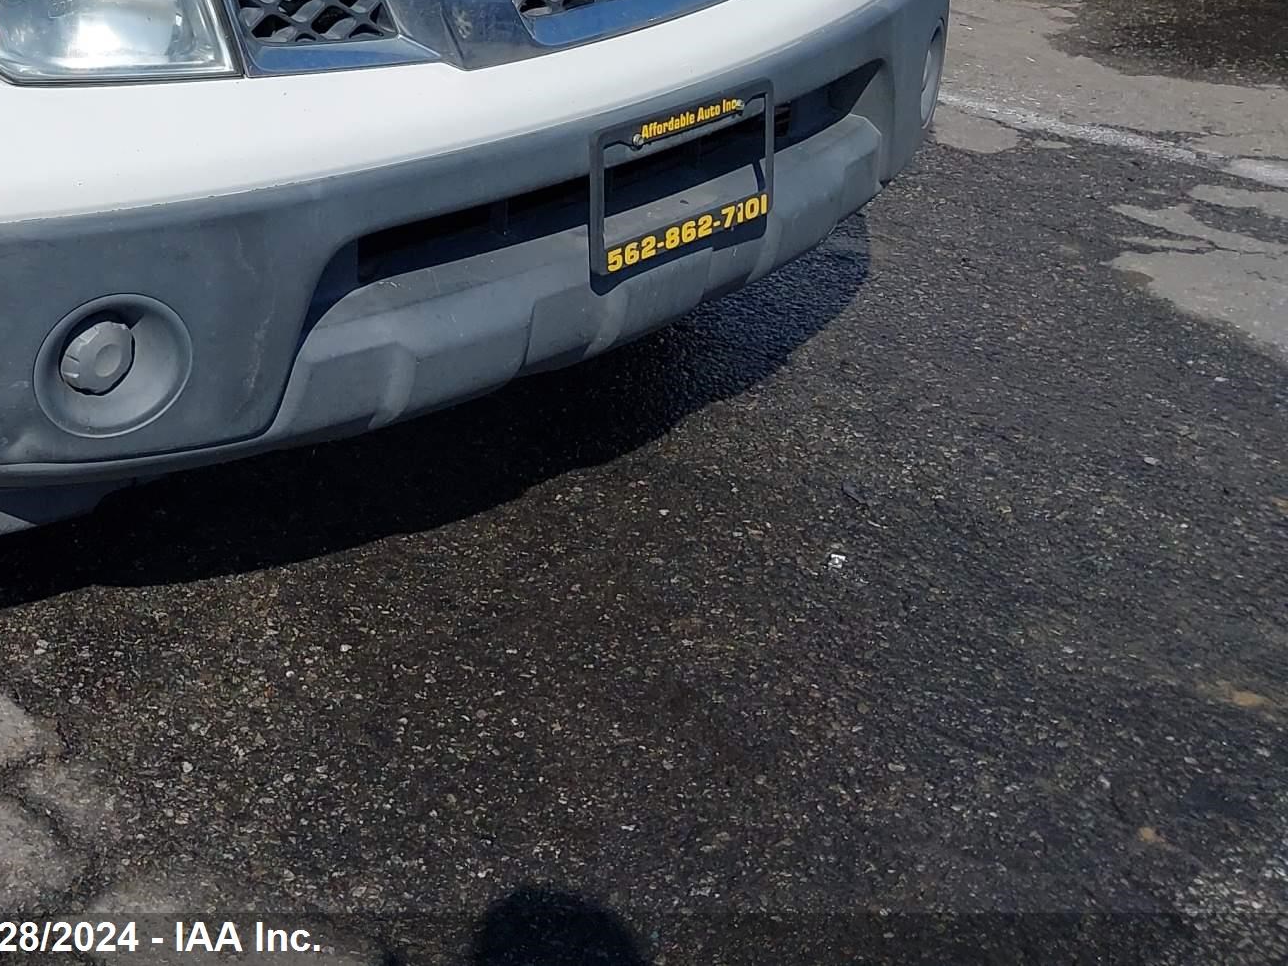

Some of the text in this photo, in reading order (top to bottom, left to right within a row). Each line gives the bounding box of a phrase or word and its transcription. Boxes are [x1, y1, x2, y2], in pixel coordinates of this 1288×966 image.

[641, 112, 695, 139] Affordable
[696, 103, 721, 123] Auto
[607, 193, 768, 273] 562-862-7101
